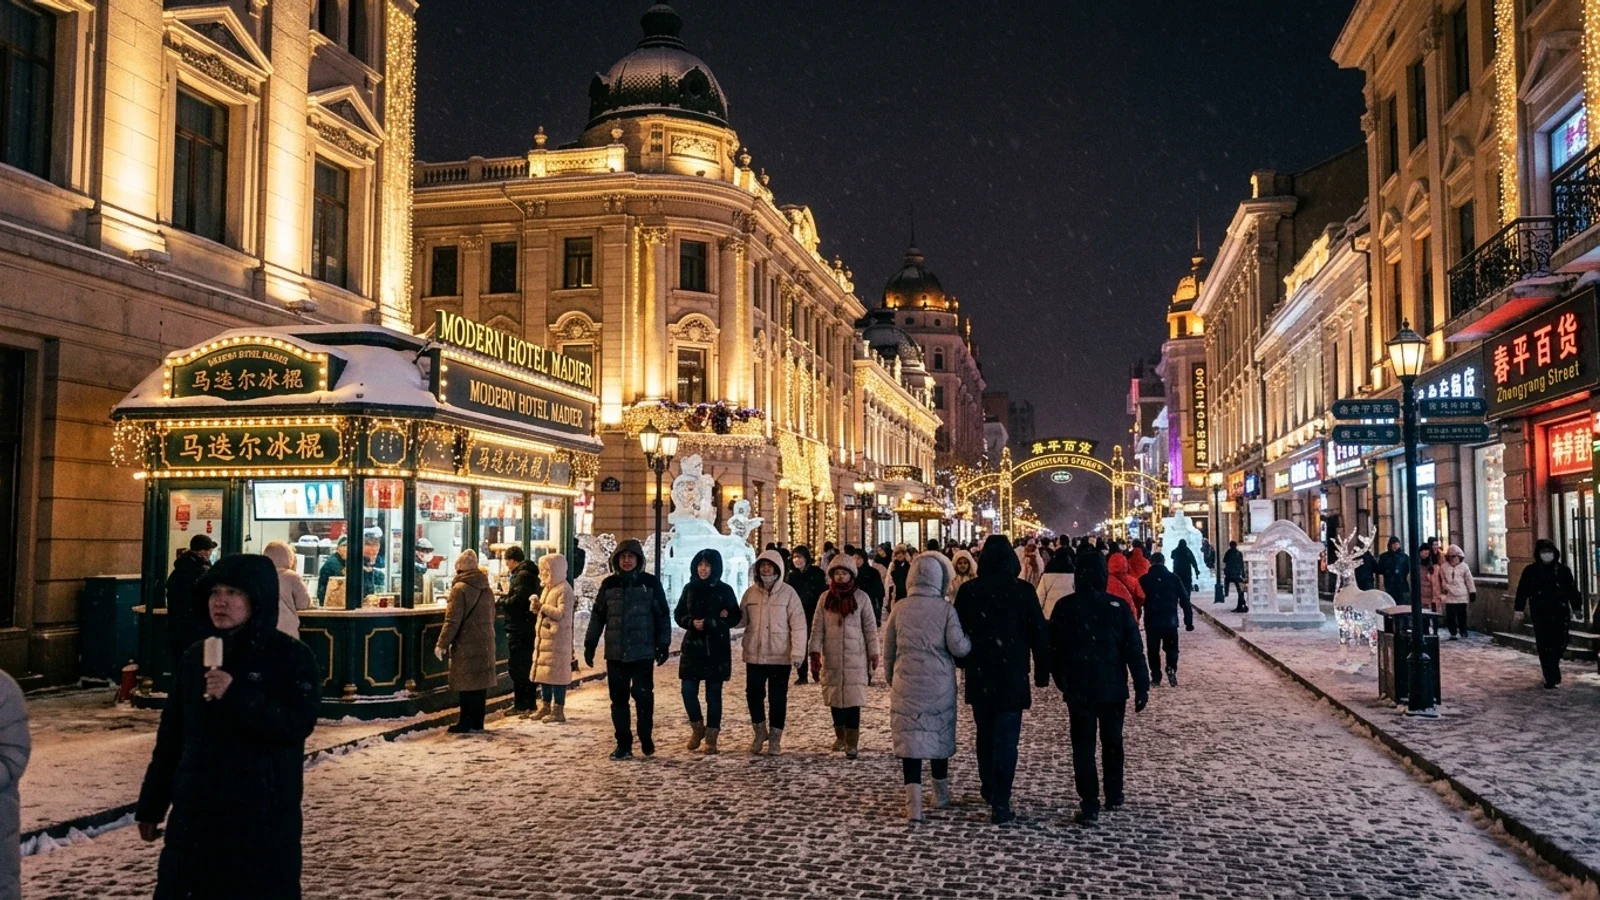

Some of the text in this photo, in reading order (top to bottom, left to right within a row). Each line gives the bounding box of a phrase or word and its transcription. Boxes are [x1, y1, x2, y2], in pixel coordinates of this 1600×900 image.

[437, 309, 504, 359] MODERN
[507, 335, 548, 374] HOTEL
[1547, 360, 1580, 386] Street
[179, 431, 324, 462] 马迭尔冰棍
